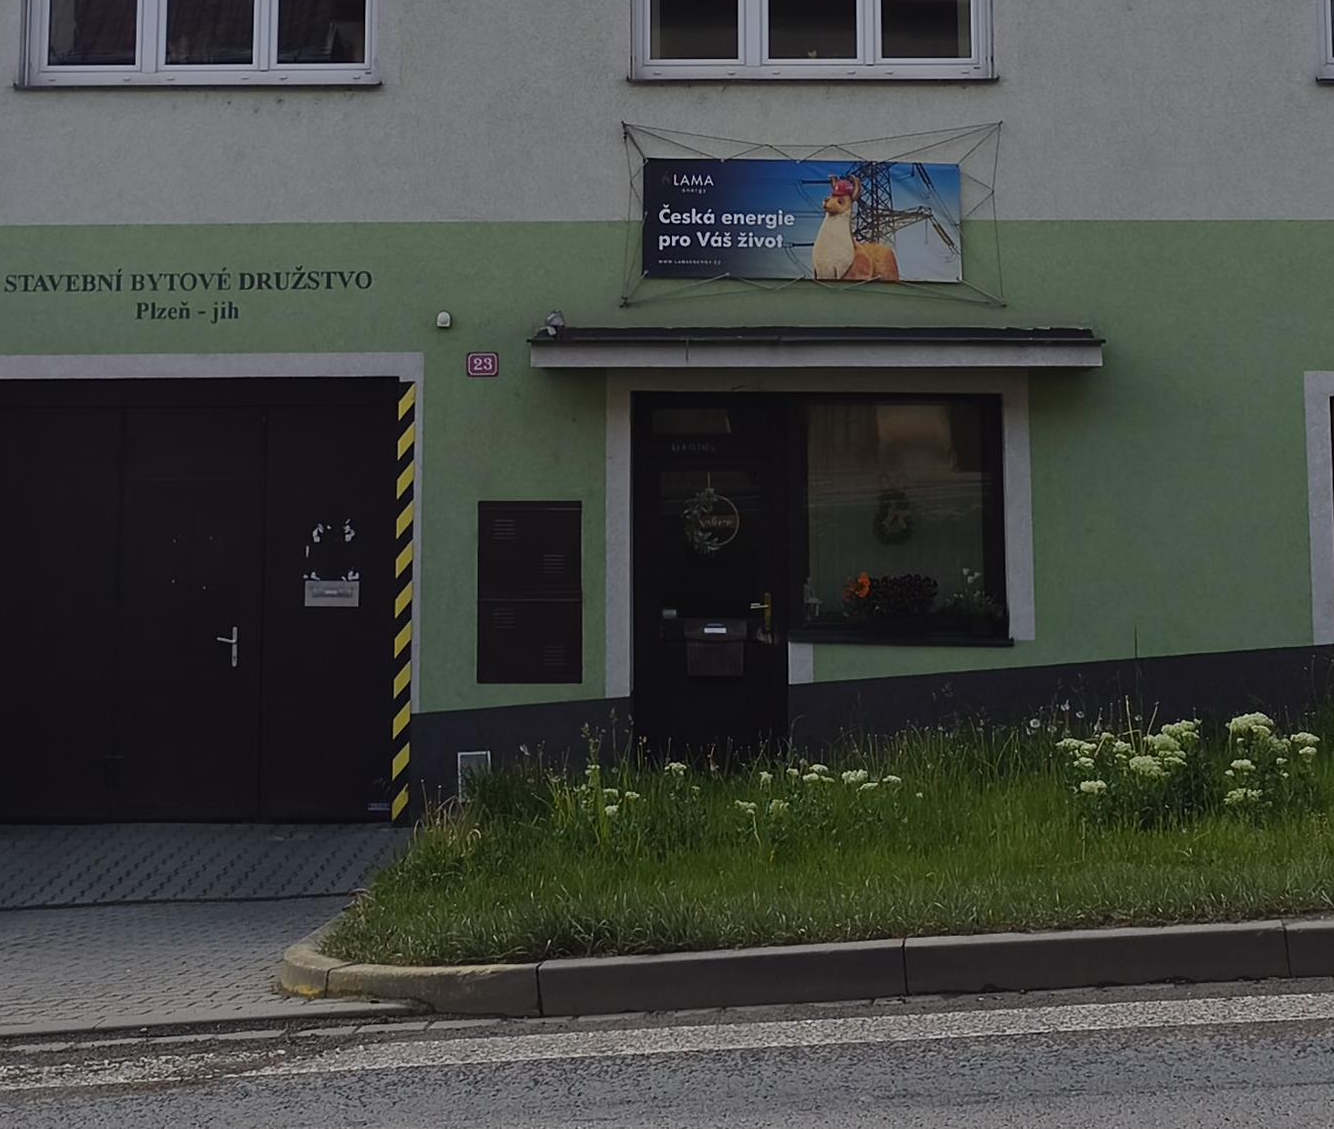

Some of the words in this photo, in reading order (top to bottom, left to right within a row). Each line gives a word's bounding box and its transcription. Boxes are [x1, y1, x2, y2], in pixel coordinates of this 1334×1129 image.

[673, 174, 714, 186] LAMA
[658, 203, 715, 226] Česká
[721, 210, 795, 229] energie
[658, 234, 692, 251] pro
[696, 231, 733, 248] Váš
[737, 231, 784, 249] život
[4, 268, 123, 293] STAVEBNÍ
[131, 267, 231, 292] BYTOVÉ
[239, 265, 373, 291] DRUŽSTVO
[135, 301, 191, 320] Plzeň
[210, 301, 240, 324] jih
[473, 357, 493, 371] 23
